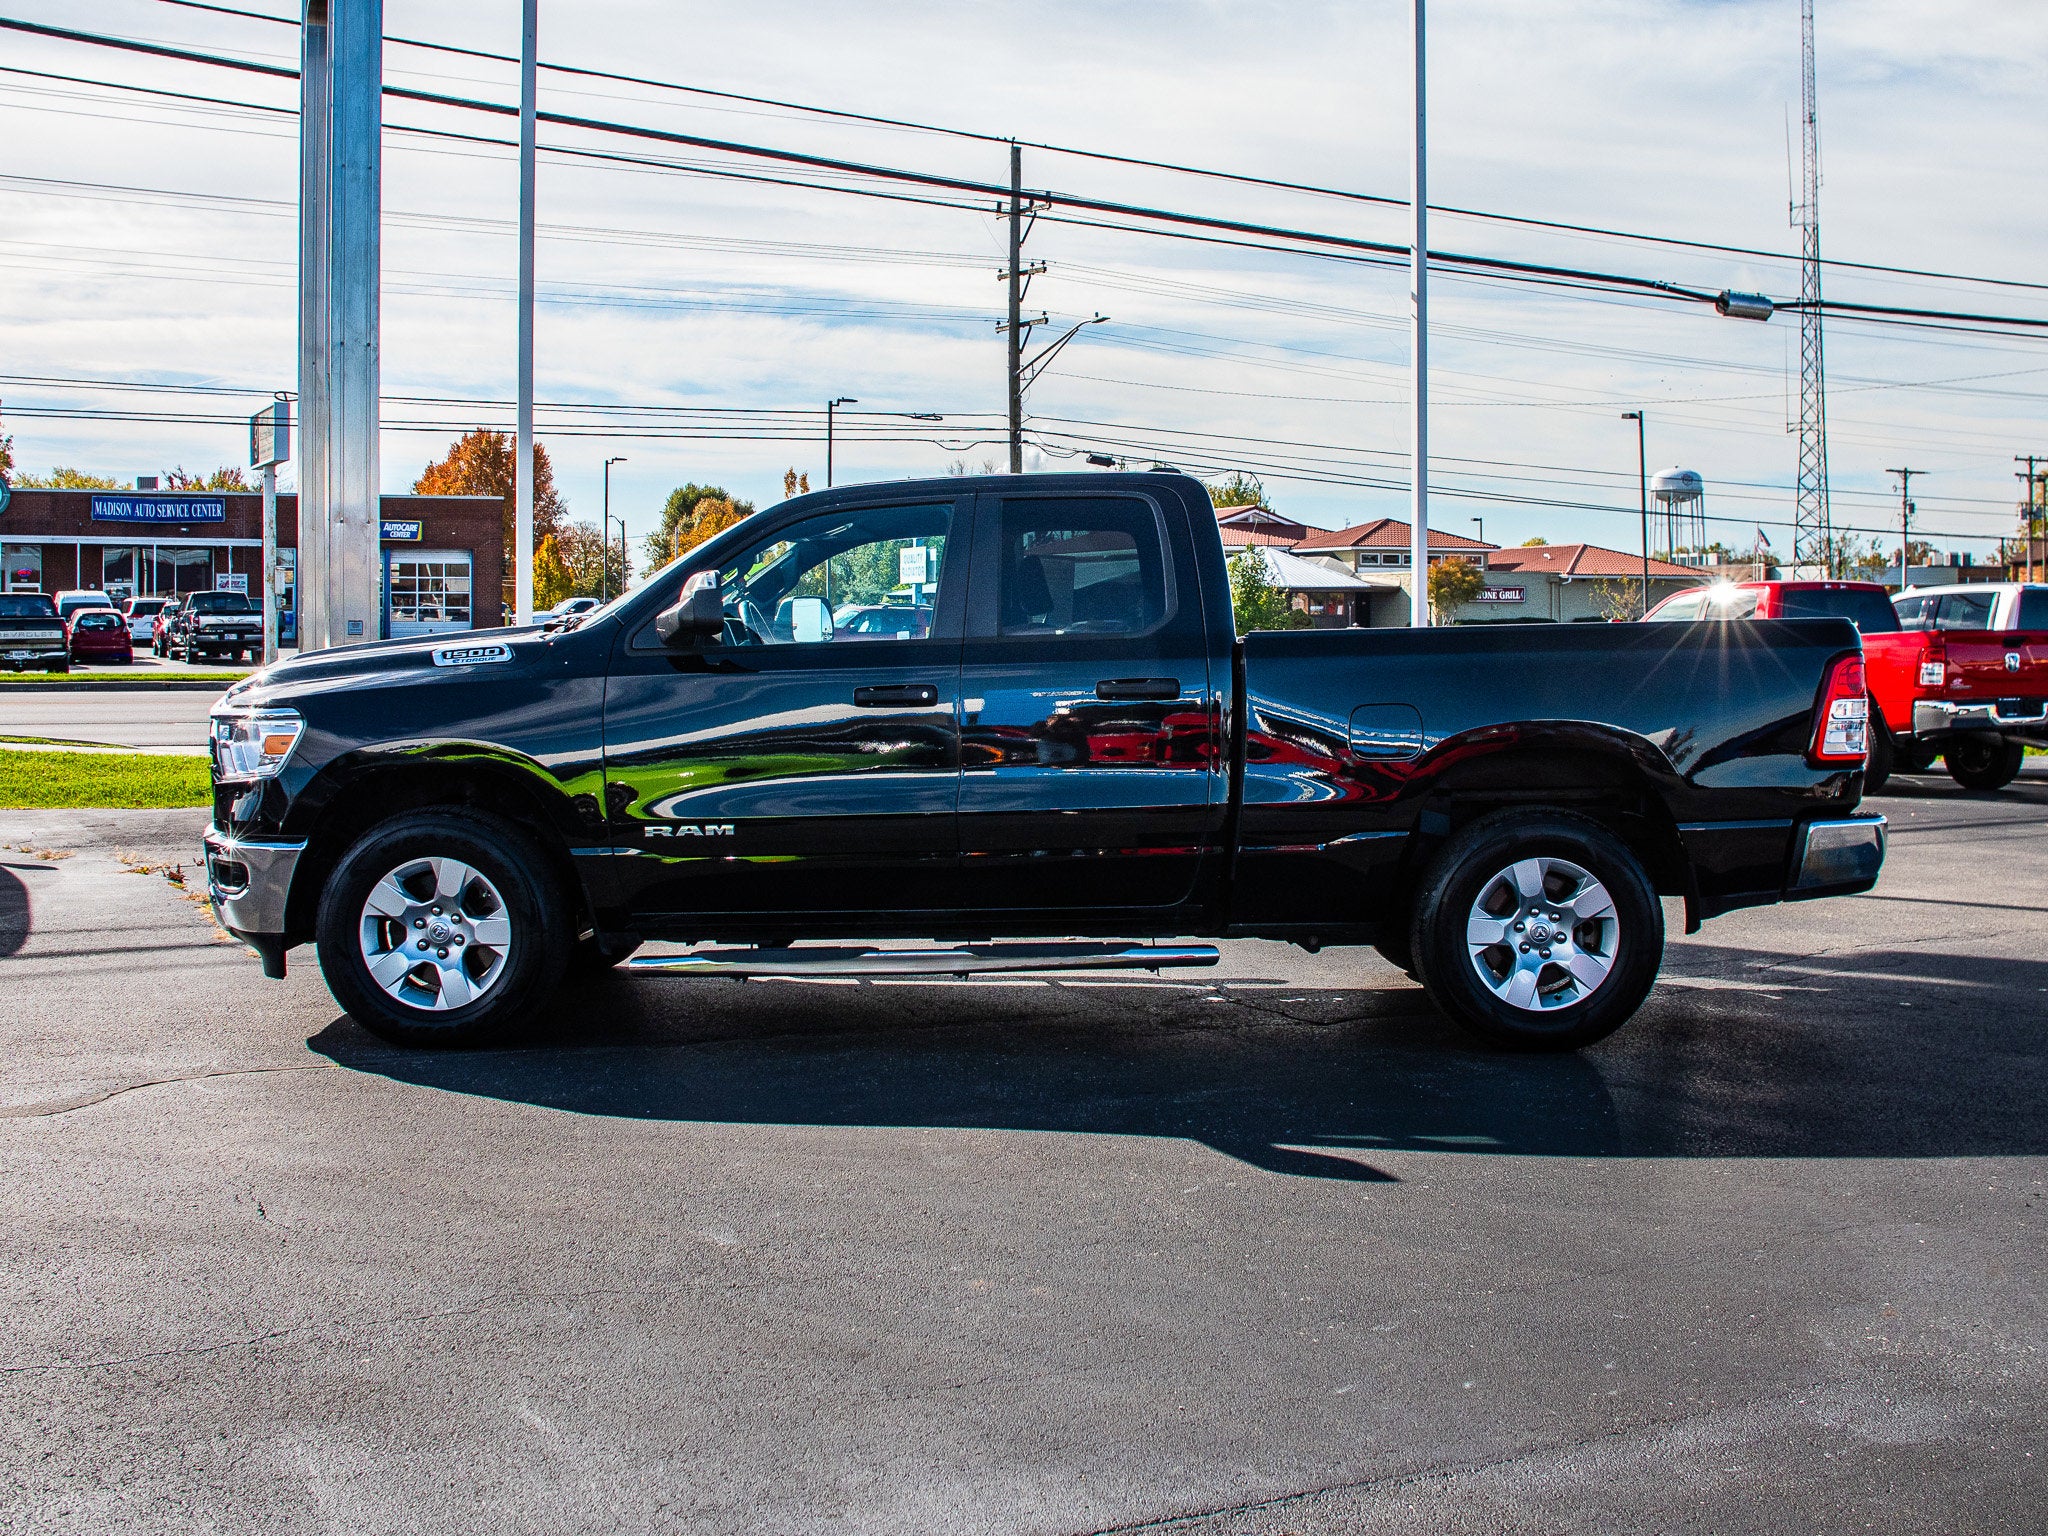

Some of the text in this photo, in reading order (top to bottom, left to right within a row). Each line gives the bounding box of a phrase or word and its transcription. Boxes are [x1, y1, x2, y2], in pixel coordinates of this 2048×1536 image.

[94, 501, 222, 518] MADISON AUTO SERVICE CENTER
[1499, 590, 1521, 600] GRILL
[445, 647, 501, 659] 1500
[644, 824, 735, 838] RAM
